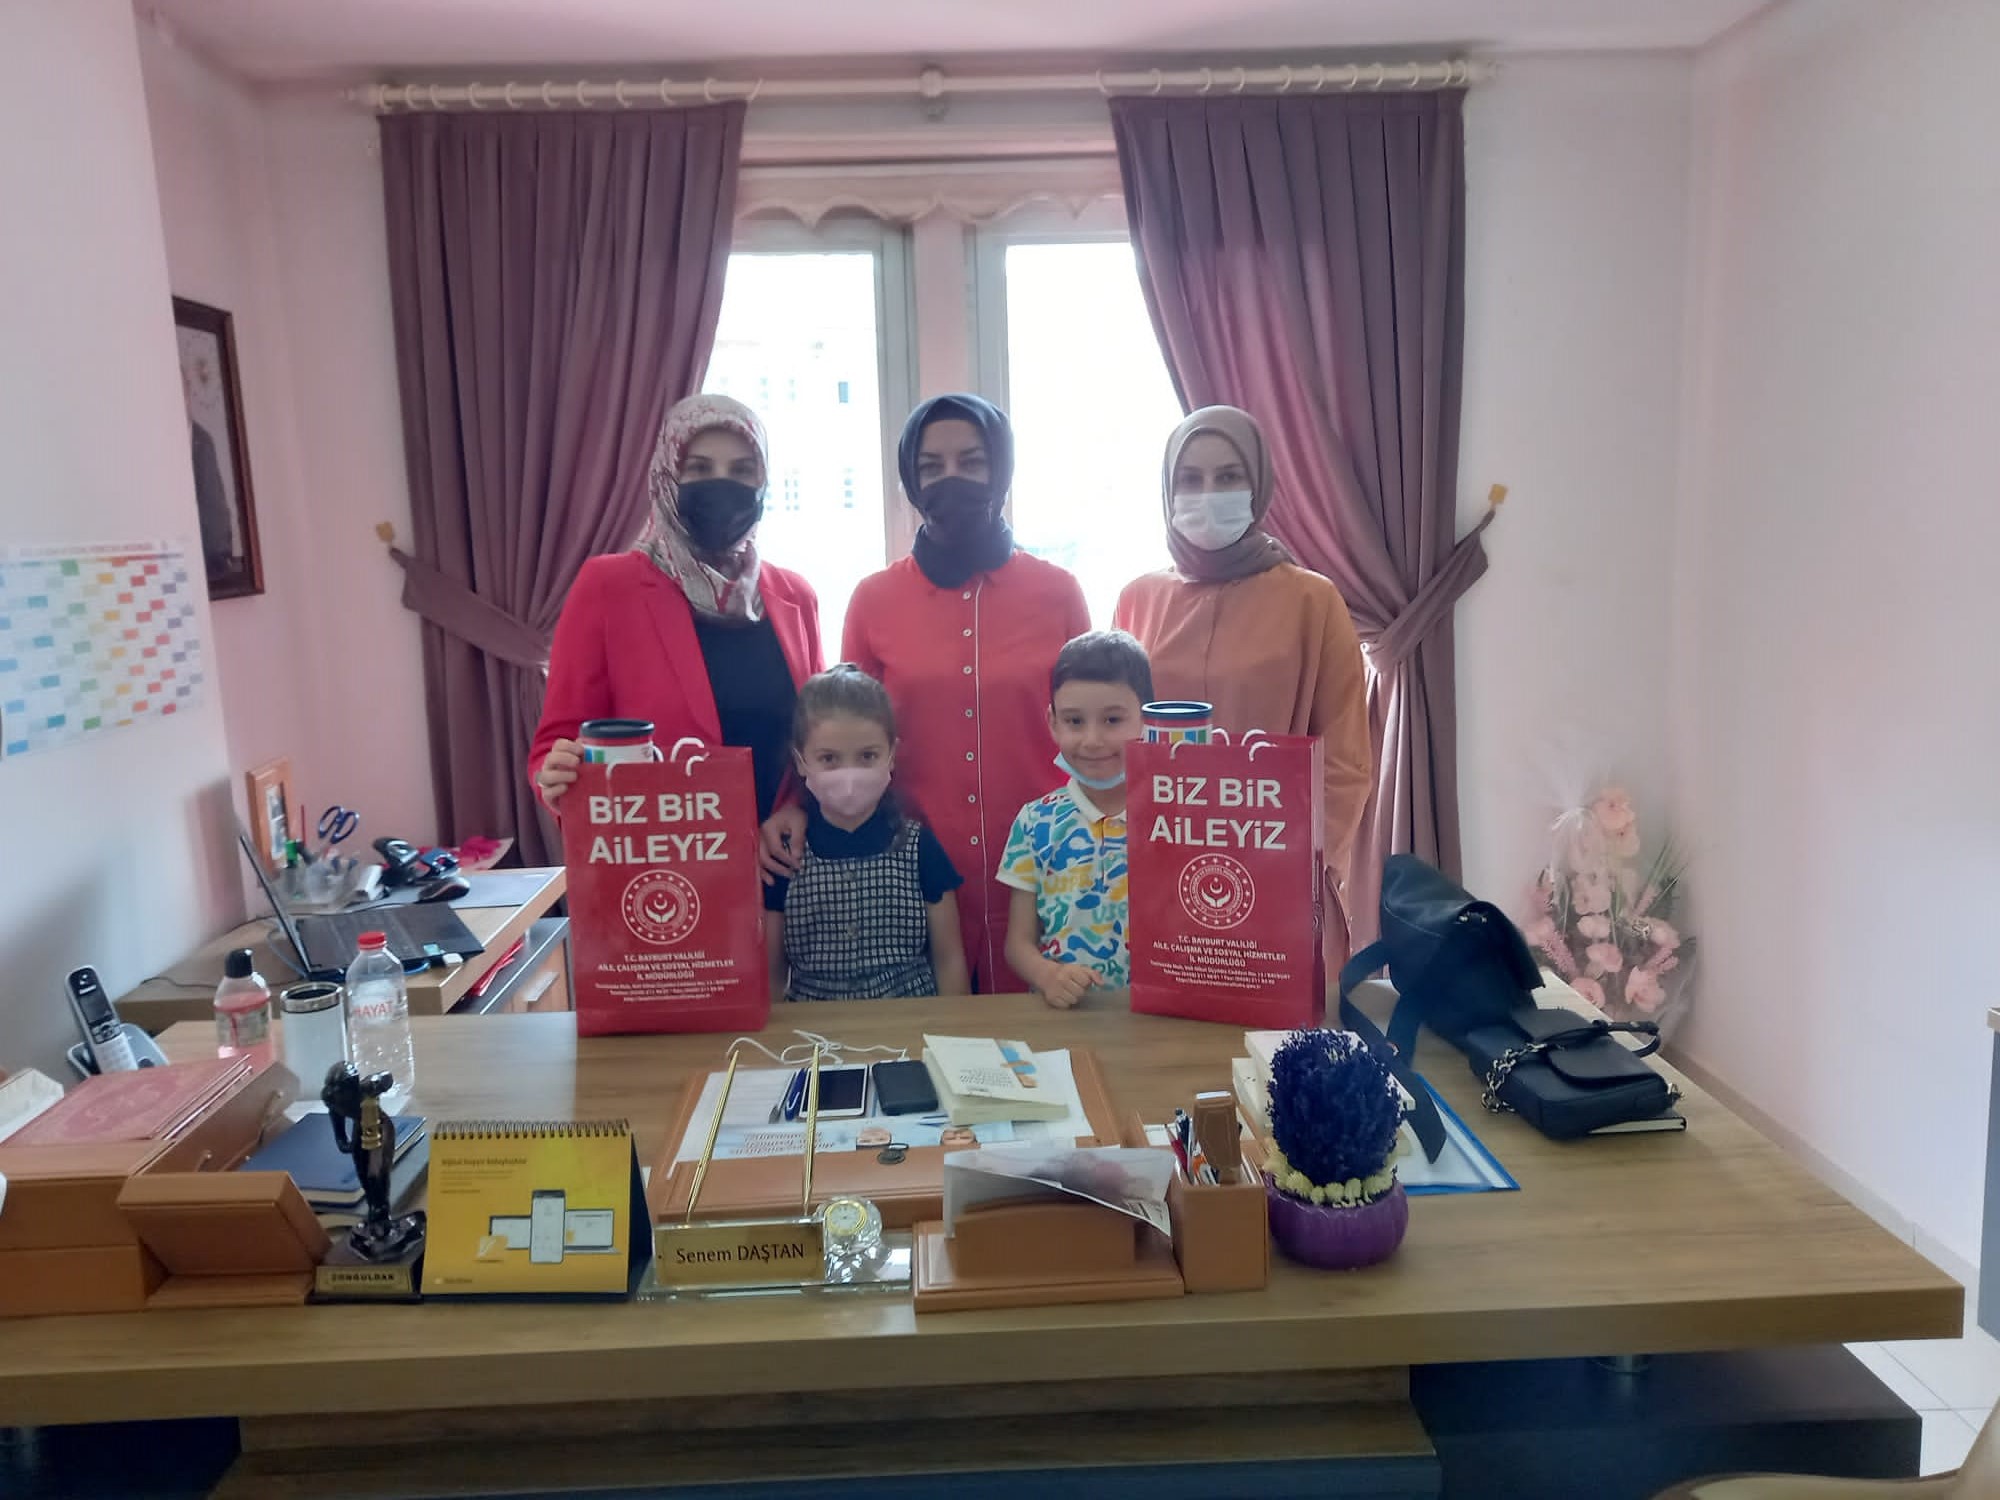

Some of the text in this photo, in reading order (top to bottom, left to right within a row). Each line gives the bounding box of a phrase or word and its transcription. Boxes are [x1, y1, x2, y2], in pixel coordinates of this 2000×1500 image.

[1191, 936, 1224, 946] BAYBURT
[1170, 943, 1202, 954] ÇALIŞMA
[1203, 947, 1213, 956] VE
[1214, 948, 1242, 958] SOSYAL
[353, 1002, 393, 1018] HAYAT
[677, 1243, 804, 1264] Senem DAŞTAN
